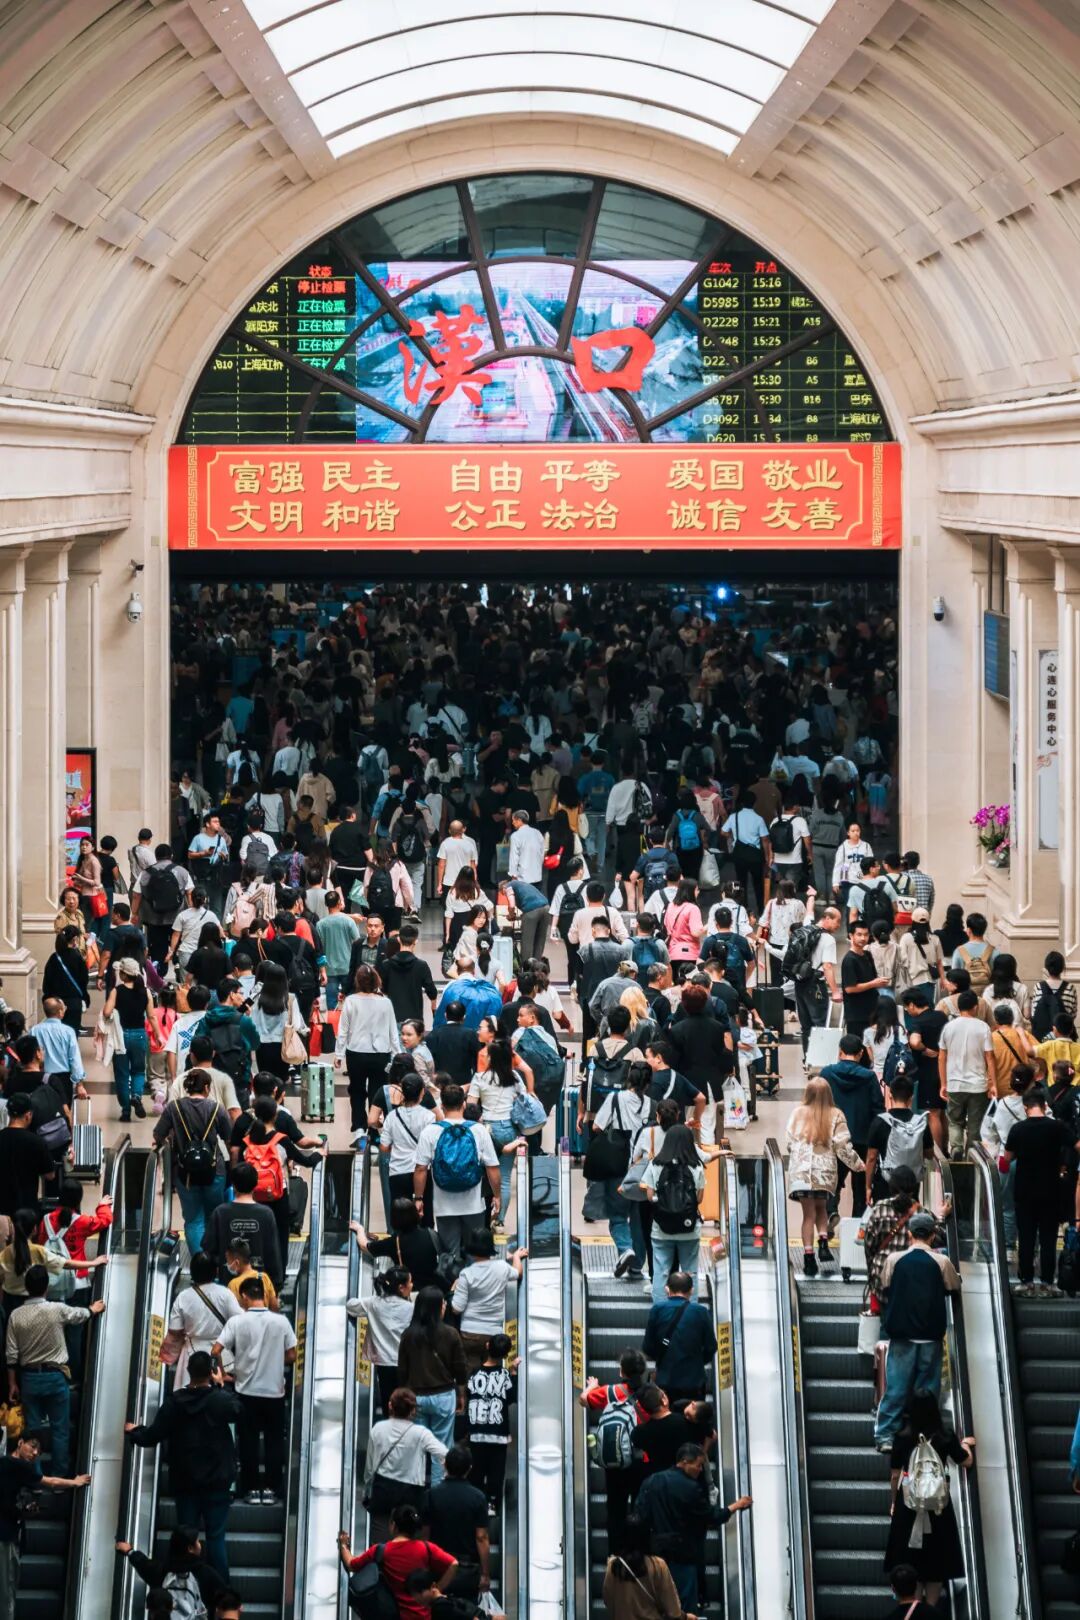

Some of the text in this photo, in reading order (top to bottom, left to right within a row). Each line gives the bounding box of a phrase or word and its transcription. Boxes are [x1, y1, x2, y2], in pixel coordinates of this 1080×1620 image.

[297, 280, 346, 294] 停止检票
[703, 277, 781, 288] G1042 15:16
[297, 299, 346, 313] 正在检票
[703, 297, 739, 308] D5985
[753, 297, 781, 308] 15:19
[297, 319, 346, 333] 正在检票
[703, 317, 739, 328] D2228
[753, 317, 780, 328] 15:21
[753, 336, 781, 347] 15:25
[753, 375, 781, 386] 15:30
[703, 414, 739, 425] D3092
[228, 458, 844, 494] 富强 民主 自由 平等 爱国 敬业
[226, 498, 844, 534] 文明 和谐 公正 法治 诚信 友善
